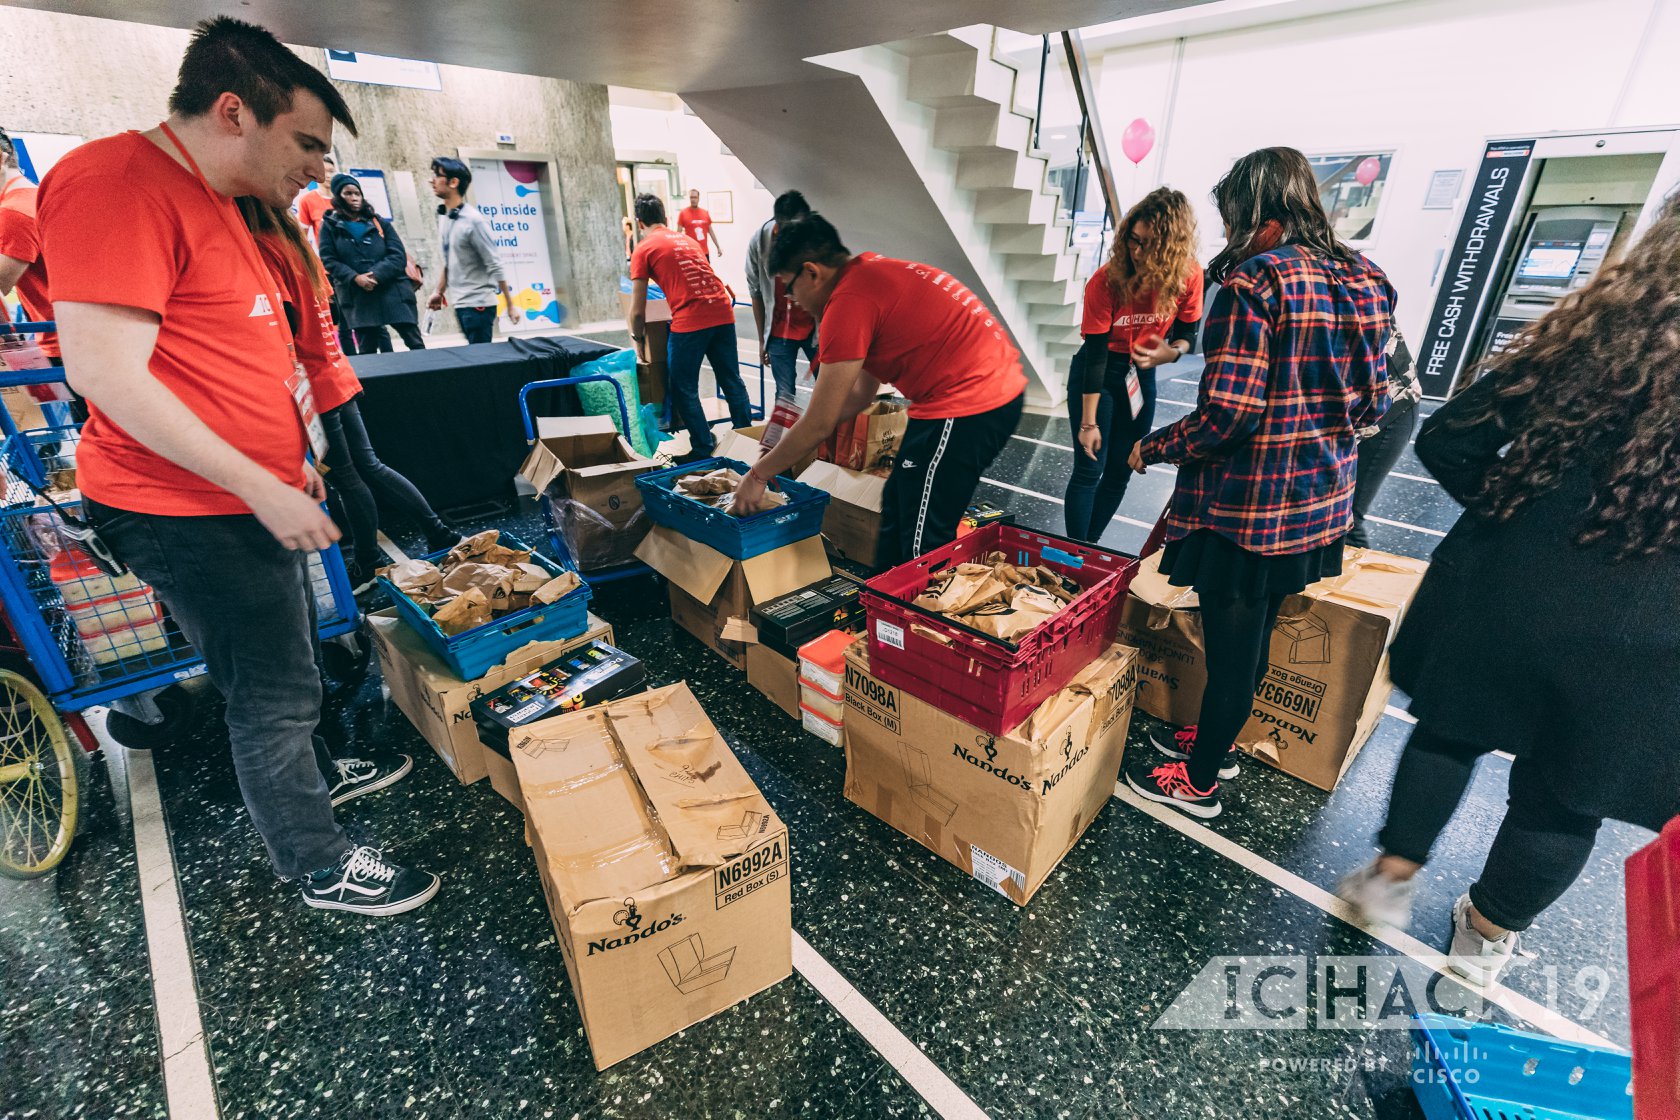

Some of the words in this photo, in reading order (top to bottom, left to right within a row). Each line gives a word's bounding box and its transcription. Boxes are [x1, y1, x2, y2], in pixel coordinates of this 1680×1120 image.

[477, 204, 498, 217] tep
[501, 203, 537, 216] inside
[491, 220, 515, 232] lace
[517, 221, 530, 232] to
[1452, 167, 1510, 297] WITHDRAWALS
[1438, 297, 1465, 337] CASH
[1426, 341, 1451, 376] FREE
[845, 663, 897, 713] N7098A
[1111, 664, 1136, 701] 7098A
[1271, 668, 1288, 681] Box
[1290, 675, 1323, 694] Orange
[845, 692, 865, 711] Black
[867, 706, 882, 721] Box
[884, 717, 897, 732] (M)
[1252, 708, 1318, 745] Nando
[952, 742, 1032, 791] Nando's
[719, 841, 782, 890] N6992A
[724, 887, 744, 904] Red
[746, 879, 764, 893] Box
[766, 870, 779, 884] (S)
[586, 913, 684, 957] Nando's
